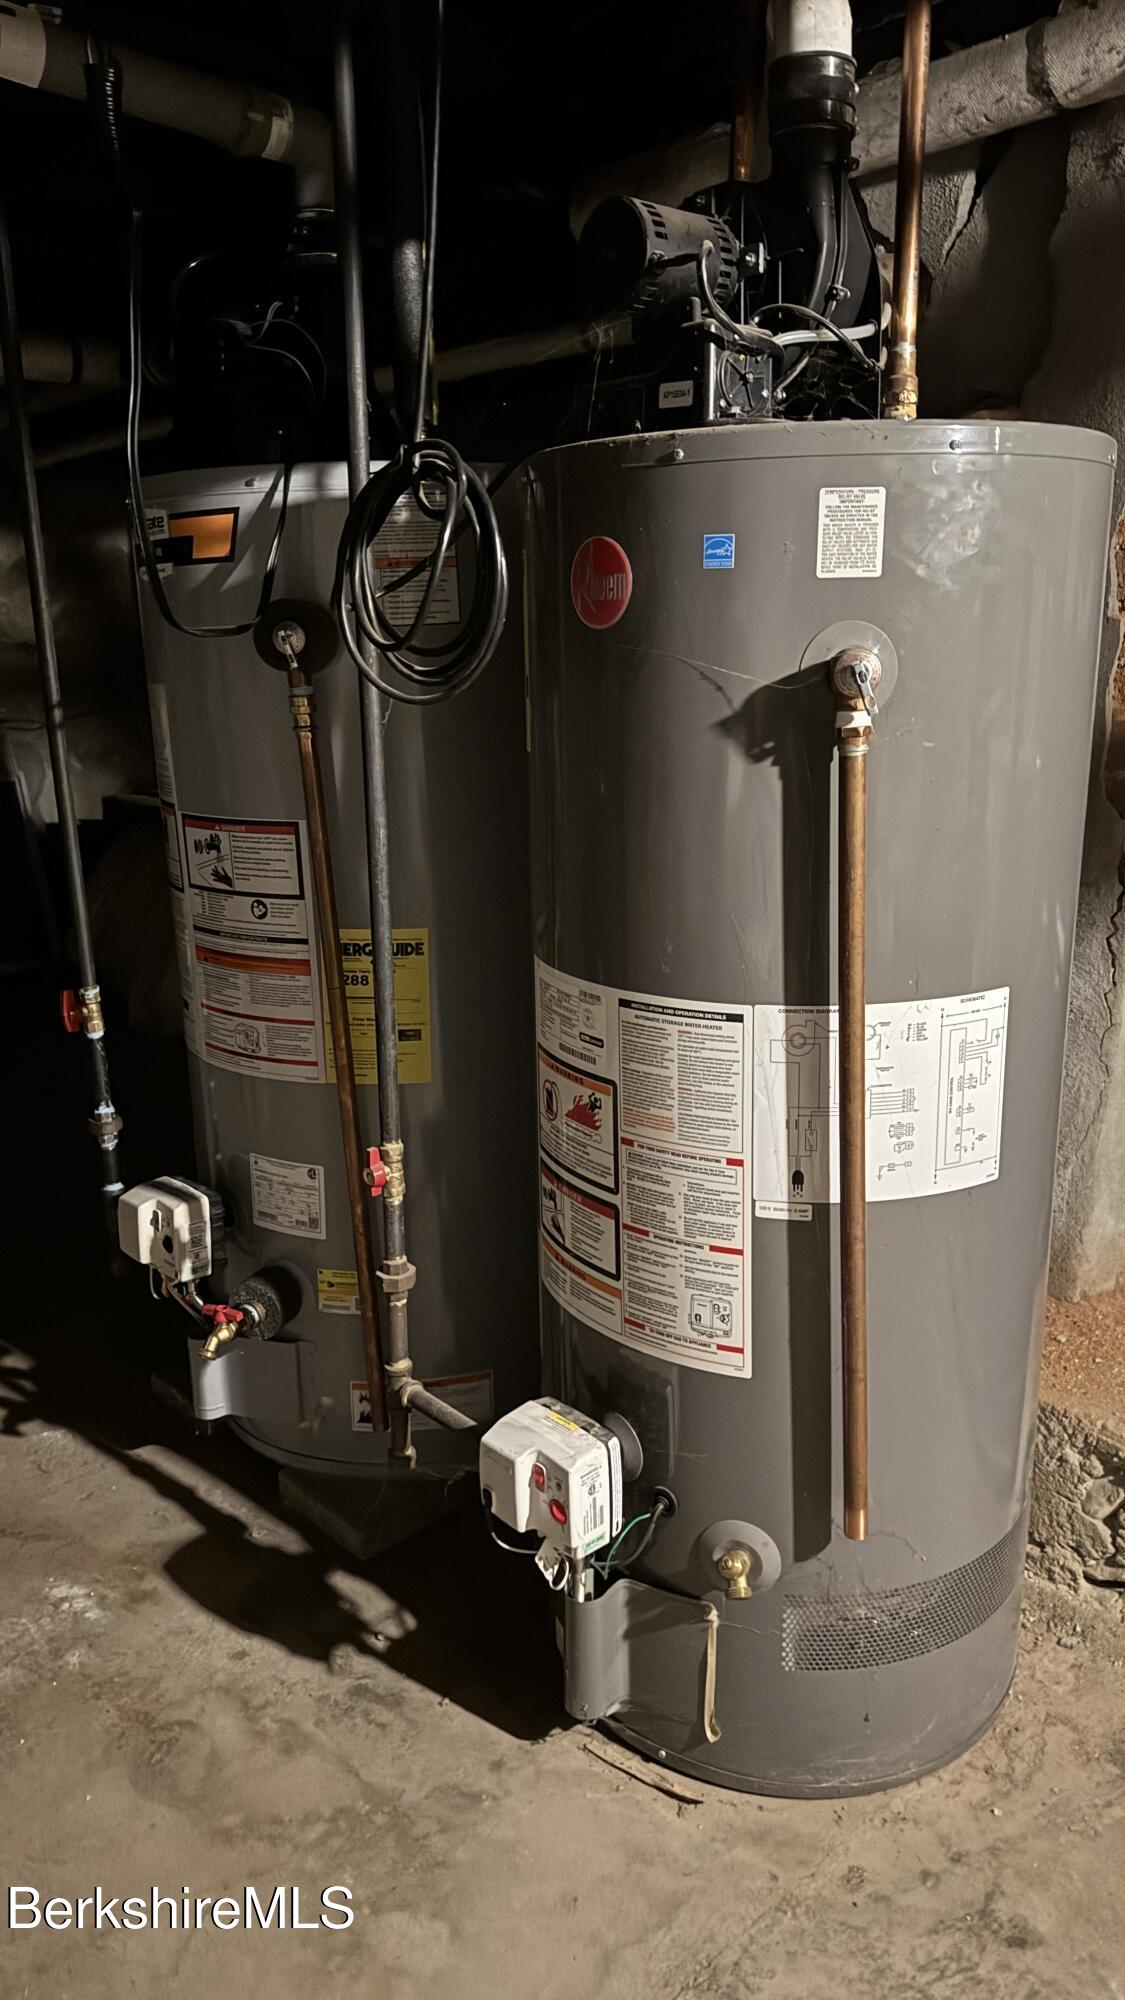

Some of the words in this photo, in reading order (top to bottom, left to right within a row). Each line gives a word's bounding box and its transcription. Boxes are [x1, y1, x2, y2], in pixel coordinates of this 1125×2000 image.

[343, 975, 369, 986] 288
[675, 1009, 704, 1018] OPERATION
[661, 1018, 683, 1027] STORAGE
[684, 1021, 702, 1029] WATER
